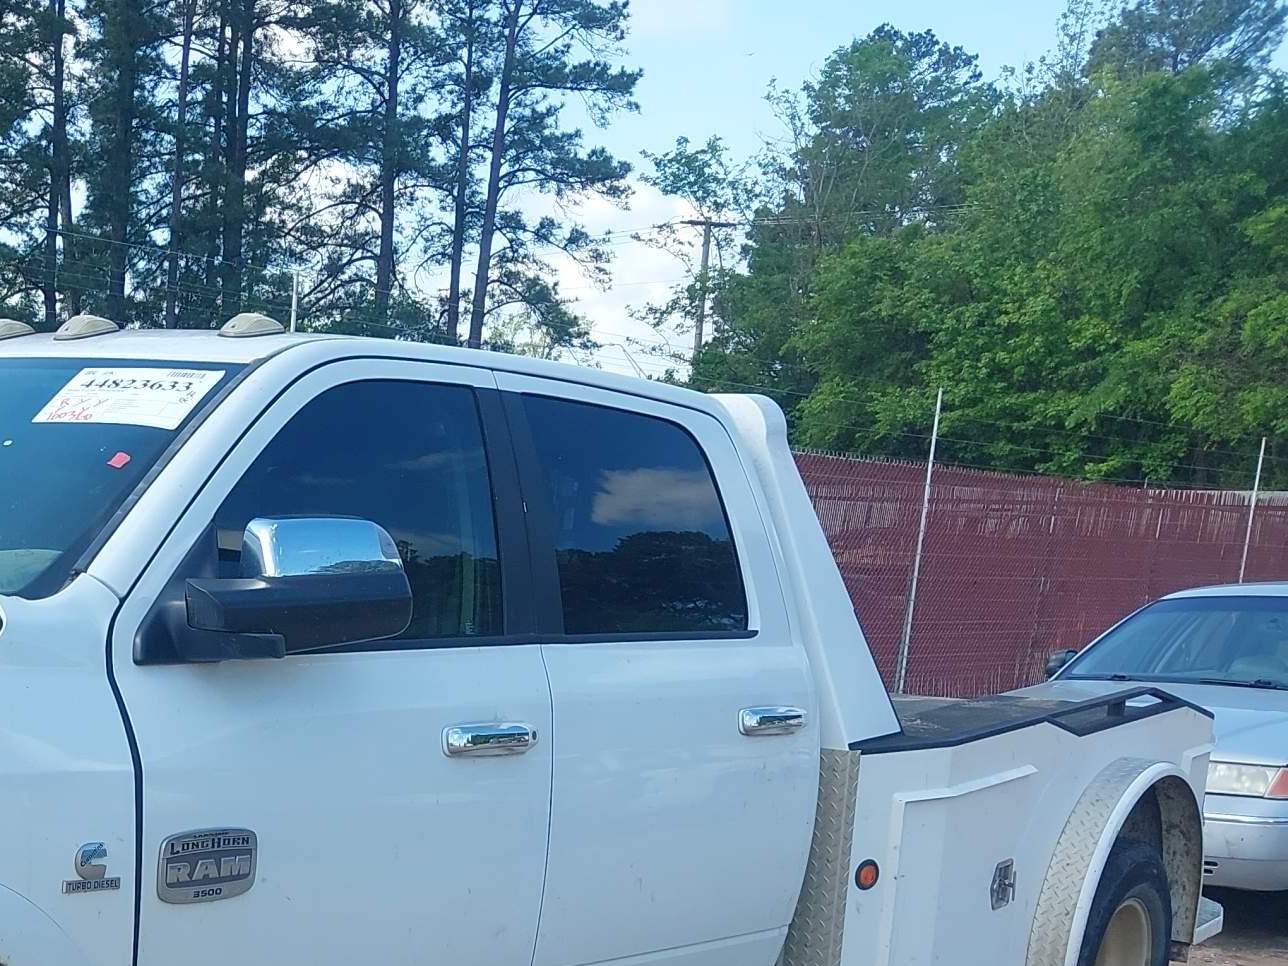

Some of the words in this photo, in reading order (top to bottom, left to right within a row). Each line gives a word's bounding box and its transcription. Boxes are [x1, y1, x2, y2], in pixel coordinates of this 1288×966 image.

[79, 378, 194, 392] 44823633
[167, 854, 251, 884] RAM
[66, 881, 92, 891] TURBO
[93, 879, 119, 889] DIESEL
[192, 887, 223, 898] 3500
